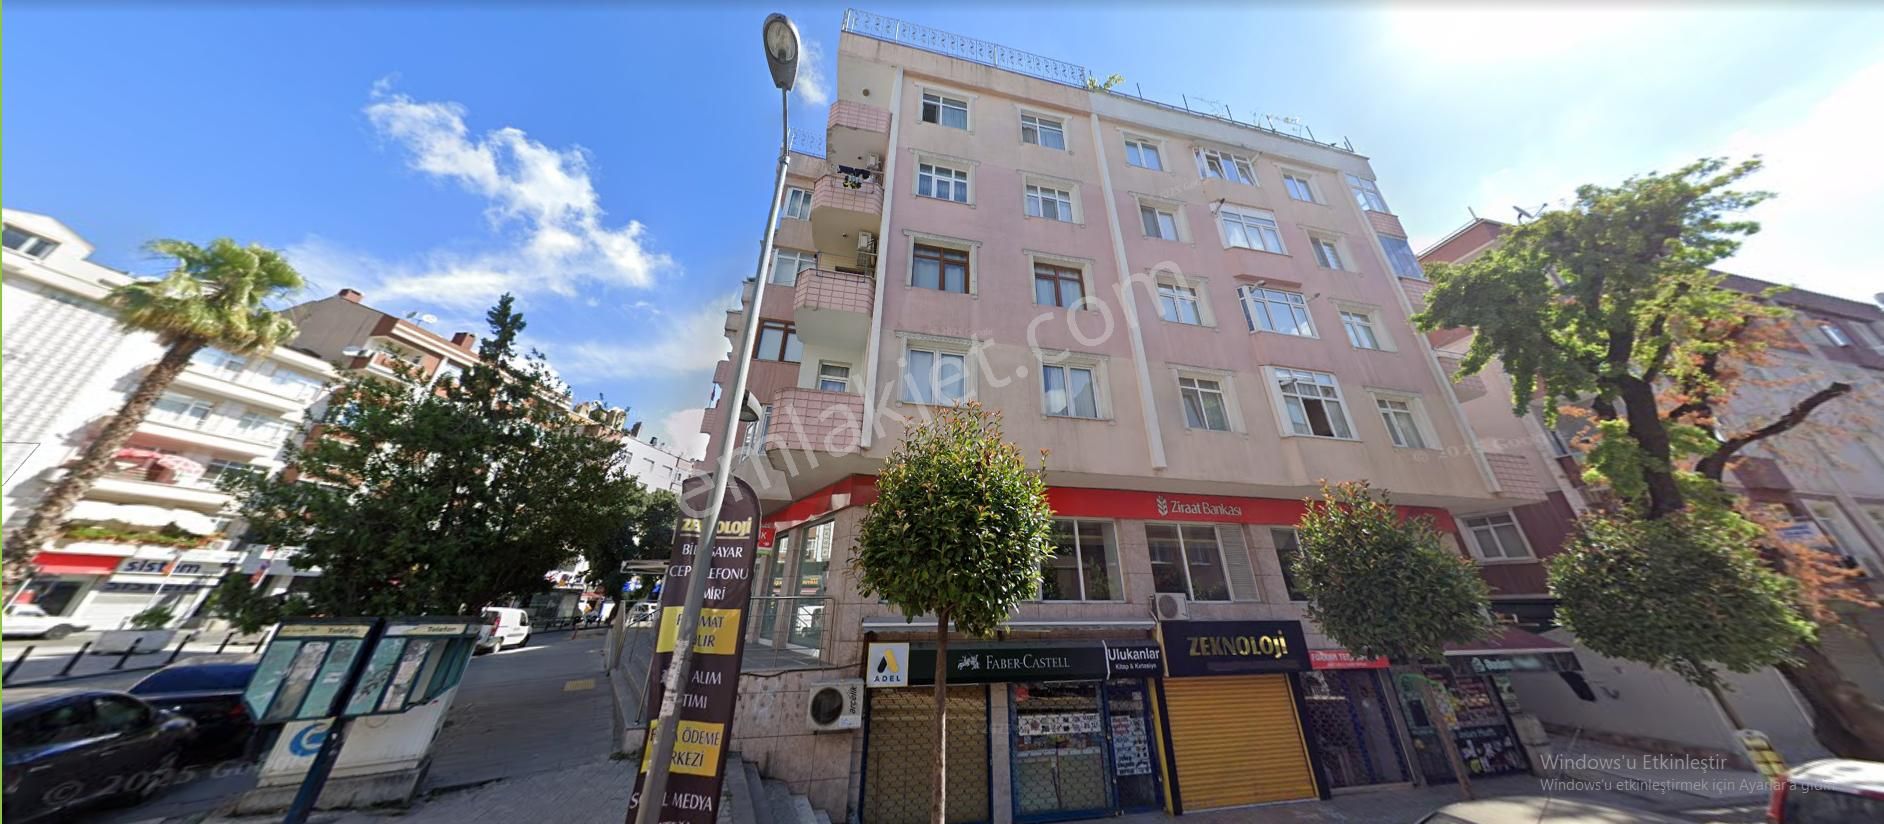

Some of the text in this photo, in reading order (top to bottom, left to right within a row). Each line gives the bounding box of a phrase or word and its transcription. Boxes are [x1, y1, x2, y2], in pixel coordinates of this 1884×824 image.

[1170, 501, 1242, 516] Ziraat Bankası
[669, 565, 692, 577] CEP
[1107, 648, 1160, 661] Ulukanlar
[691, 670, 722, 684] ALIM
[682, 727, 720, 745] ÖDEME
[672, 792, 712, 812] MEDYA
